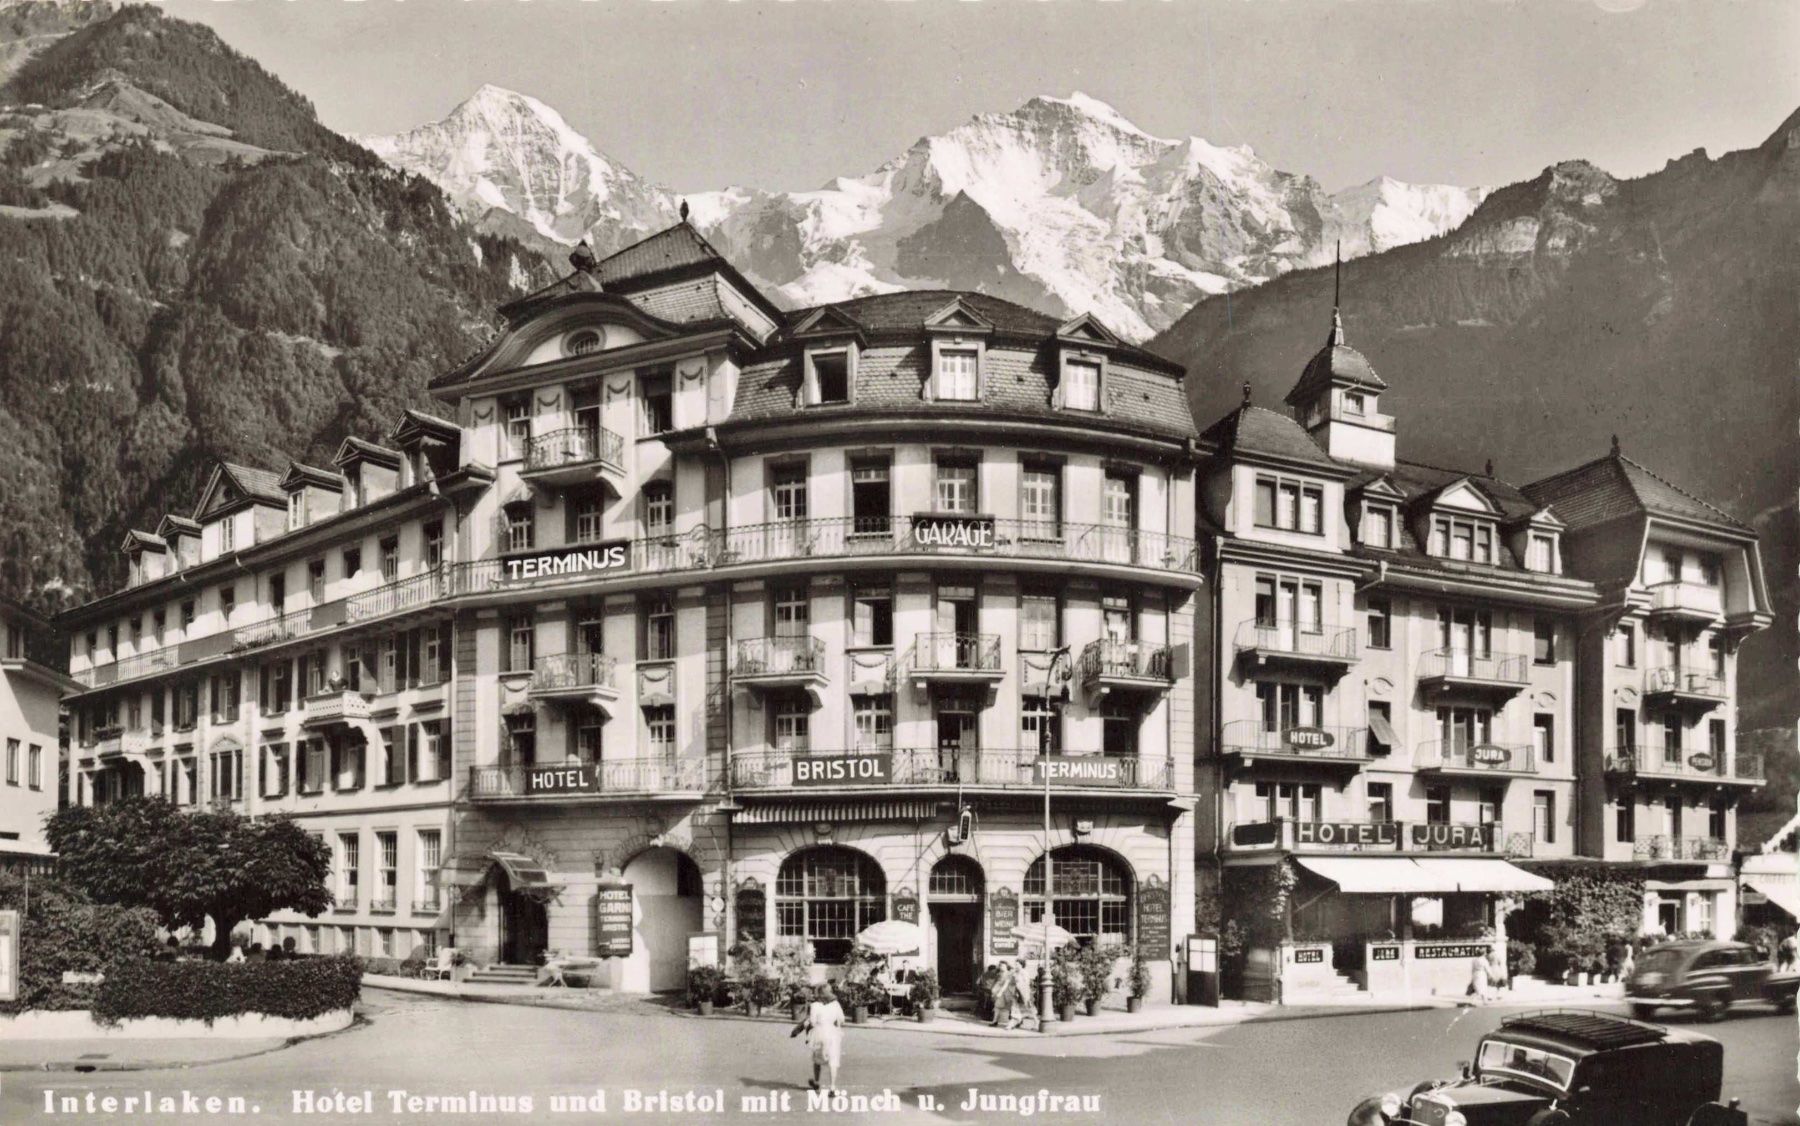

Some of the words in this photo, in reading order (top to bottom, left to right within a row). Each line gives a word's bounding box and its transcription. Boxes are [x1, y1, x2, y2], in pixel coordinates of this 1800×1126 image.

[914, 519, 994, 547] GARAGE
[507, 546, 626, 580] TERMINUS
[1290, 731, 1327, 745] HOTEL
[1475, 749, 1504, 761] JURA
[797, 758, 885, 780] BRISTOL
[1037, 761, 1117, 779] TERMINUS
[532, 770, 589, 789] HOTEL
[1299, 824, 1395, 843] HOTEL
[1417, 826, 1483, 845] JURA
[599, 890, 631, 900] HOTEL
[599, 902, 632, 914] GARNI
[1297, 951, 1321, 963] HOTEL
